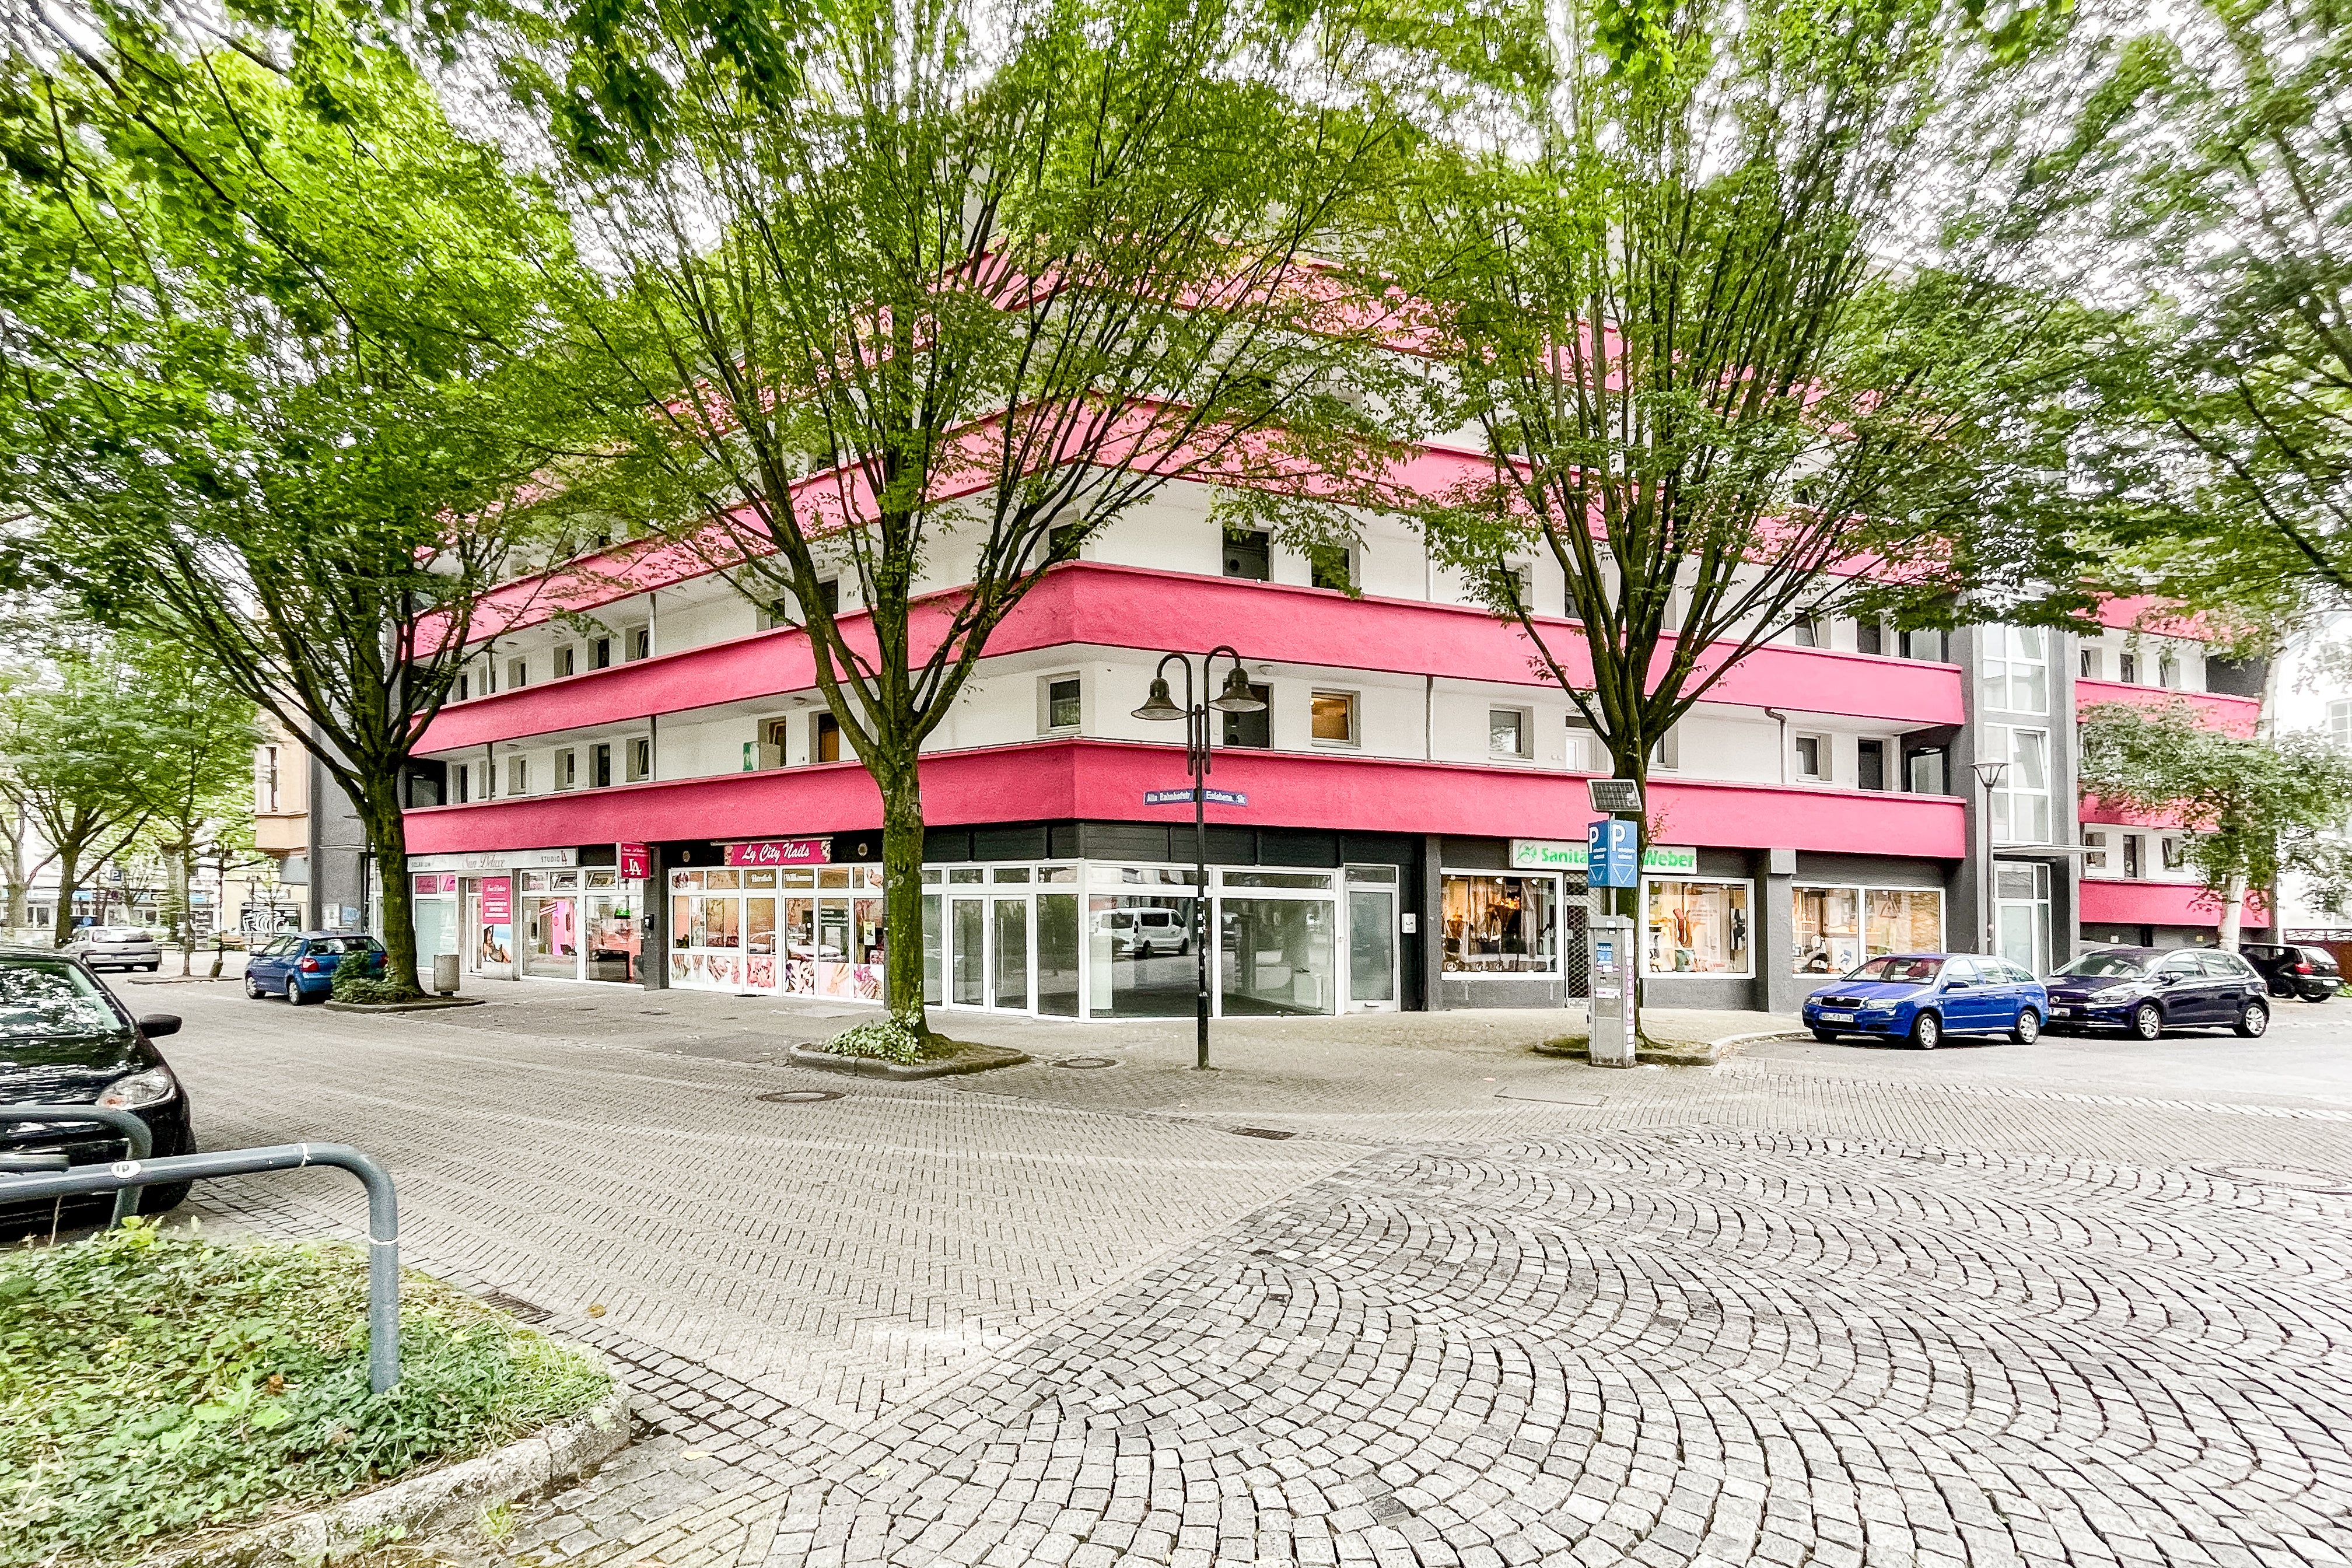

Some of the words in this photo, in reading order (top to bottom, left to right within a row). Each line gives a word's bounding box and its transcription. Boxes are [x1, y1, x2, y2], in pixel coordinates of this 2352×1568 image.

[1589, 826, 1599, 853] P
[1612, 824, 1626, 852] P
[741, 845, 757, 863] Ly
[759, 844, 780, 863] City
[782, 842, 810, 859] Nails
[1644, 850, 1695, 867] Weber
[628, 858, 642, 876] LA
